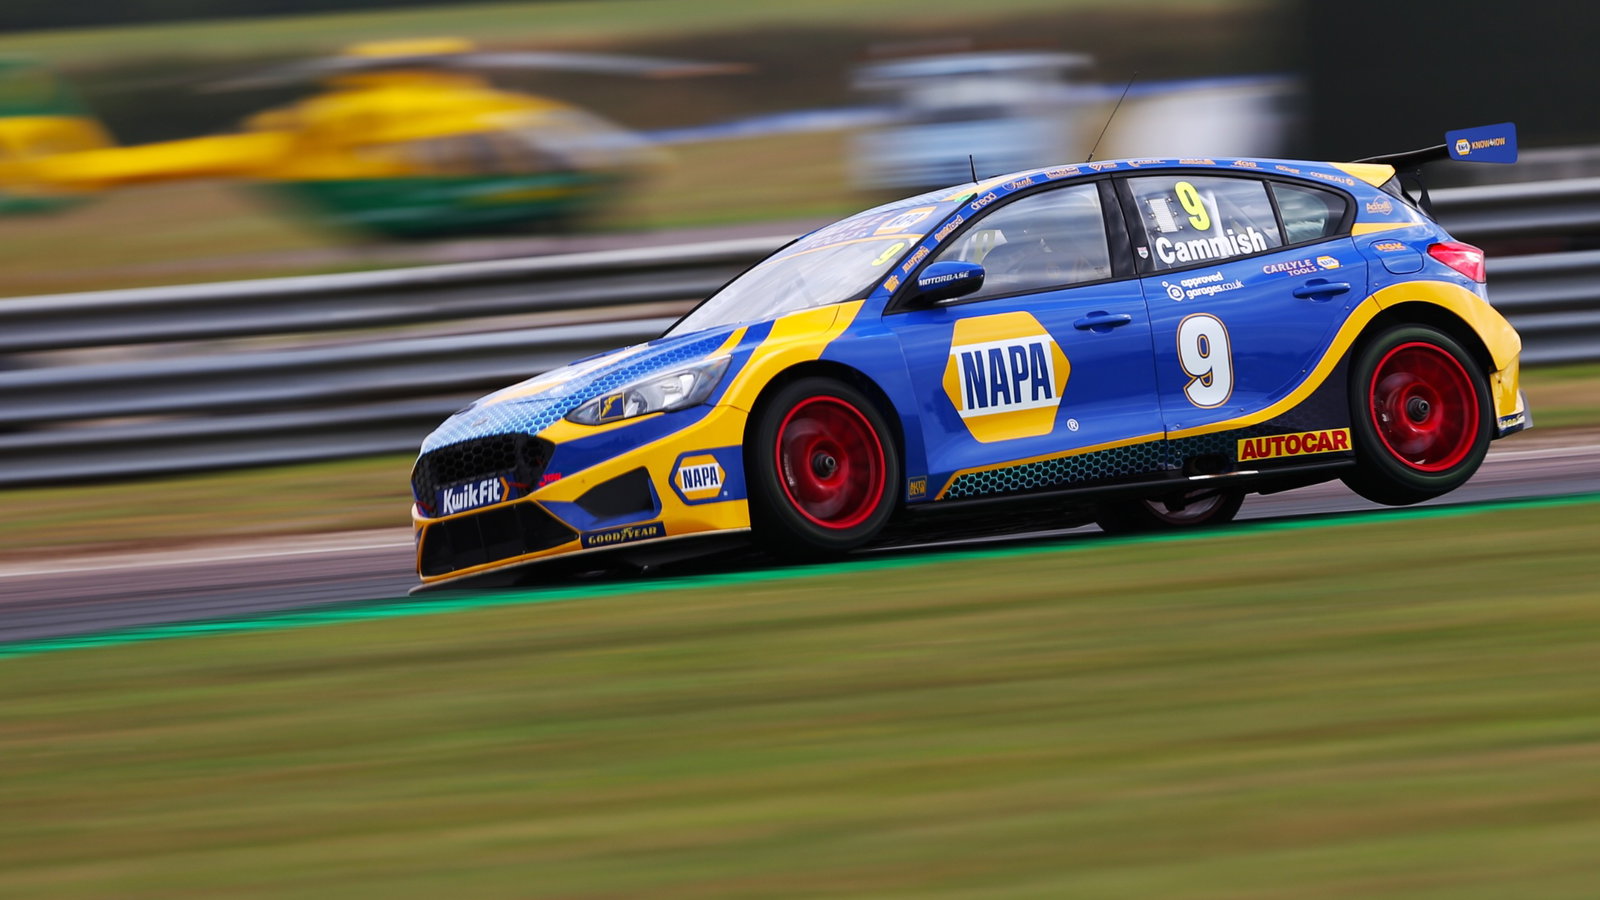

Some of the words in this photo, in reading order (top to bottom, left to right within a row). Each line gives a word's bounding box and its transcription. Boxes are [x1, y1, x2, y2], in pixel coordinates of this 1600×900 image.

[1175, 181, 1211, 231] 9
[871, 242, 905, 267] 9
[1155, 226, 1267, 264] Cammish
[1263, 258, 1313, 275] CARLYLE
[1287, 265, 1317, 277] TOOLS
[918, 270, 969, 287] MOTORBASE
[1180, 271, 1223, 288] approved
[1185, 279, 1244, 300] garages.co.uk
[1176, 312, 1234, 409] 9
[961, 342, 1052, 410] NAPA
[1241, 430, 1348, 460] AUTOCAR
[682, 466, 719, 489] NAPA
[588, 526, 657, 545] GOODYEAR
